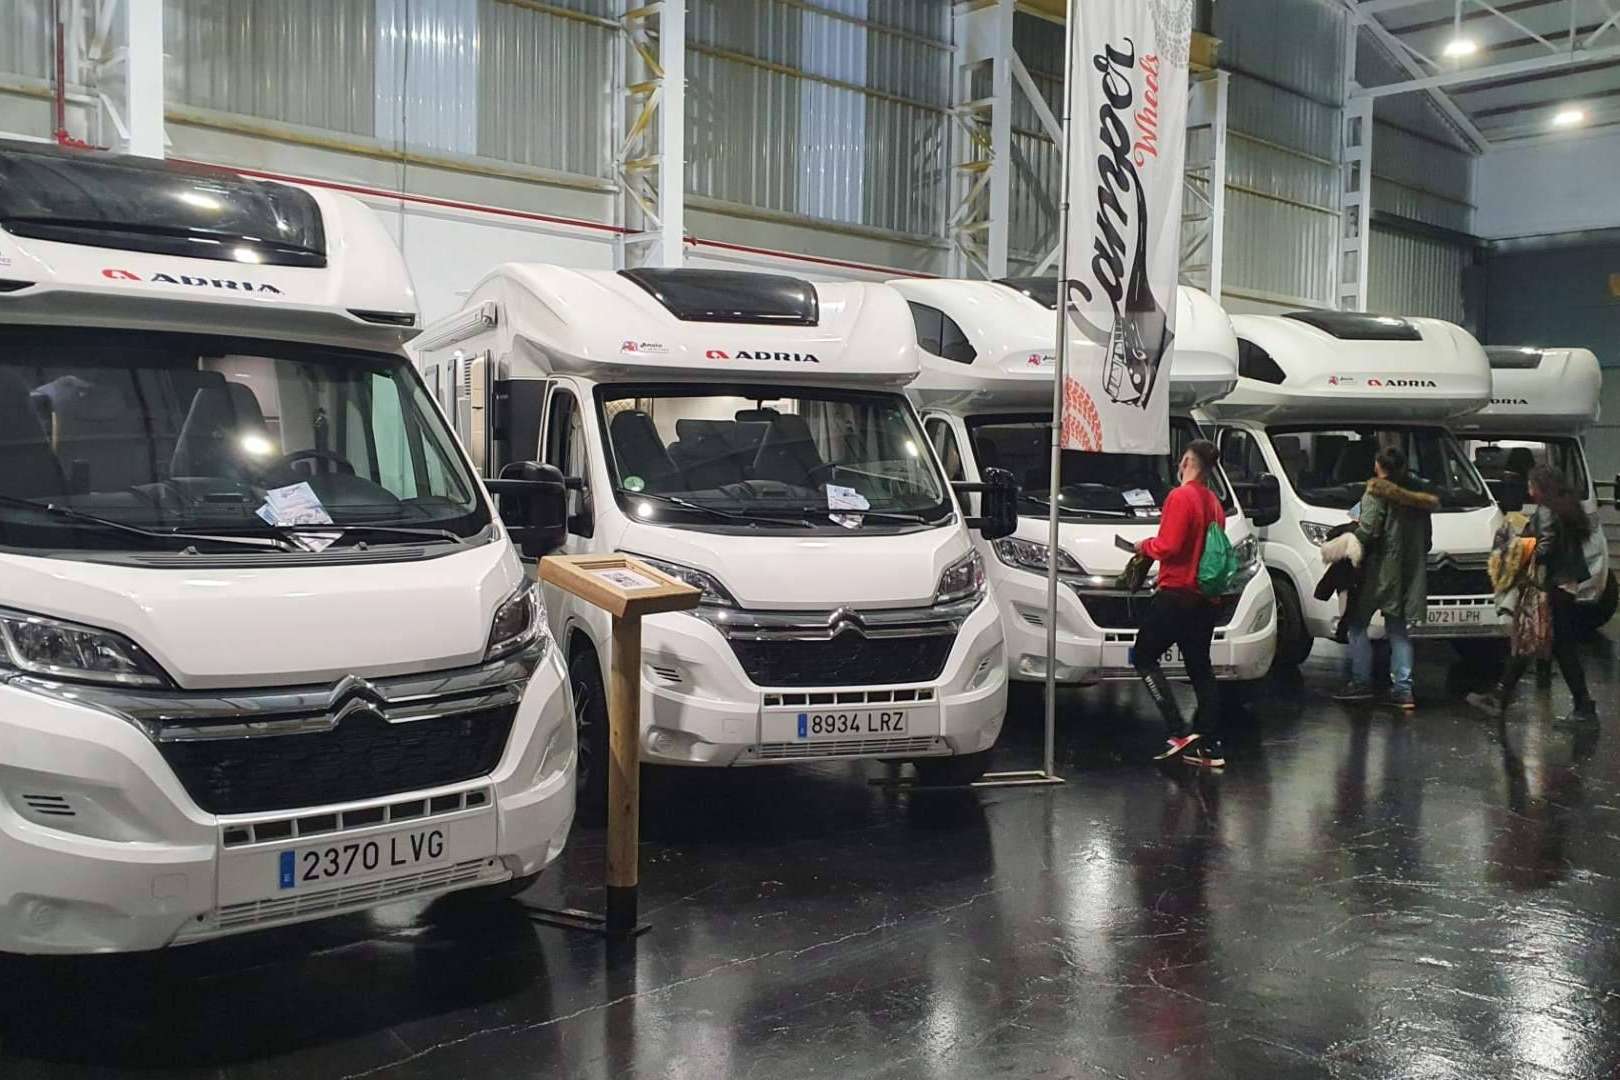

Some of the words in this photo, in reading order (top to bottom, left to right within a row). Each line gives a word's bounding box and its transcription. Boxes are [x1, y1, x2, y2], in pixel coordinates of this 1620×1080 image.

[1132, 53, 1160, 168] Wheels
[1068, 37, 1137, 350] Camper
[150, 272, 284, 295] ADRIA
[735, 350, 820, 363] ADRIA
[1385, 379, 1437, 388] ADRIA
[1428, 611, 1456, 622] 0721
[811, 713, 860, 734] 8934
[868, 711, 904, 732] LRZ
[302, 841, 380, 881] 2370
[390, 830, 444, 867] LVG
